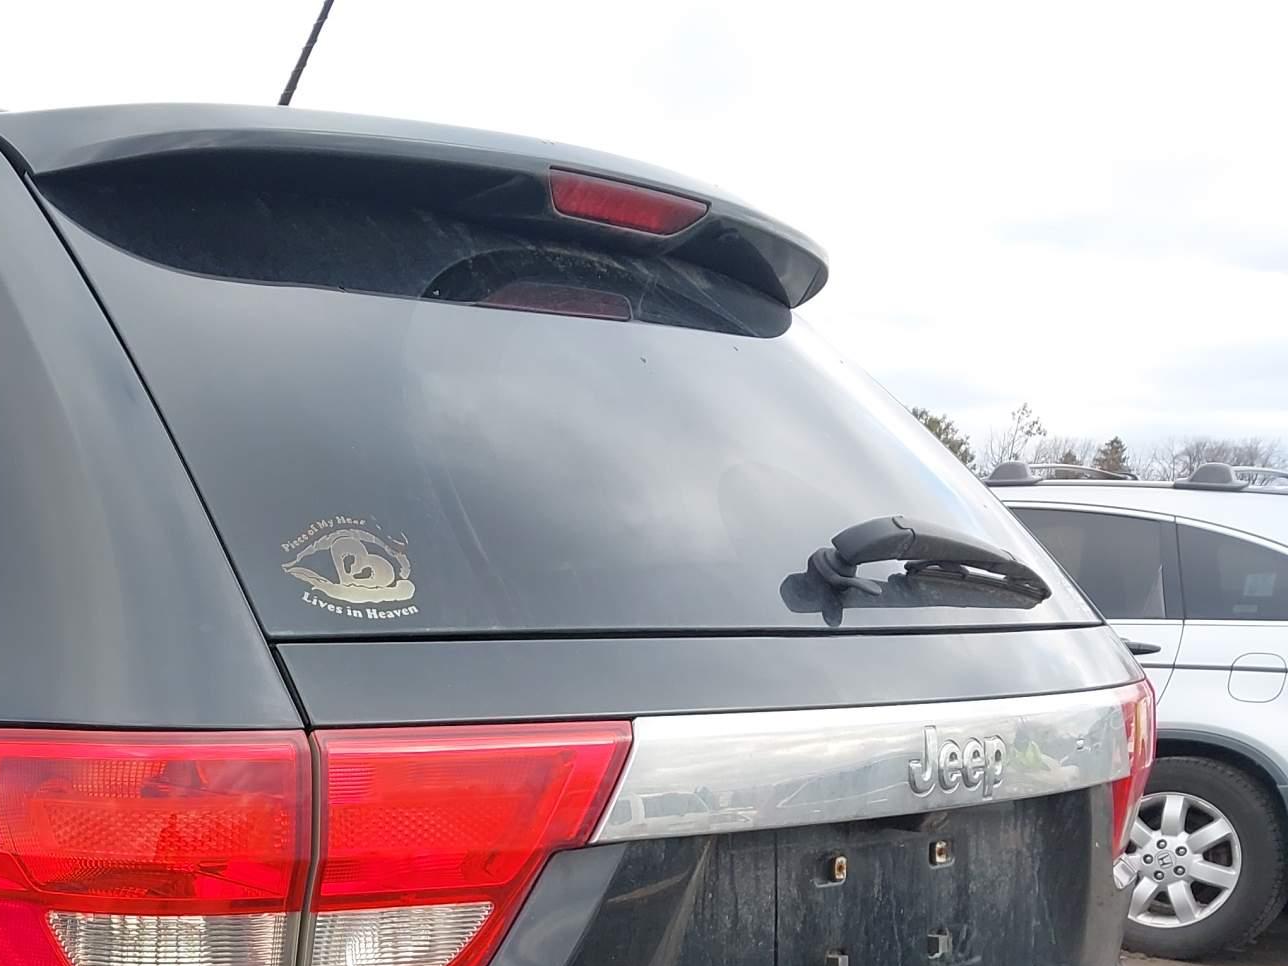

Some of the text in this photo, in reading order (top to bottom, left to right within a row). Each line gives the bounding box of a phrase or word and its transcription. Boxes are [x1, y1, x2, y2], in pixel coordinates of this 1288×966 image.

[316, 519, 334, 529] My
[302, 591, 419, 620] Lives in Heaven
[908, 725, 1008, 800] Jeep
